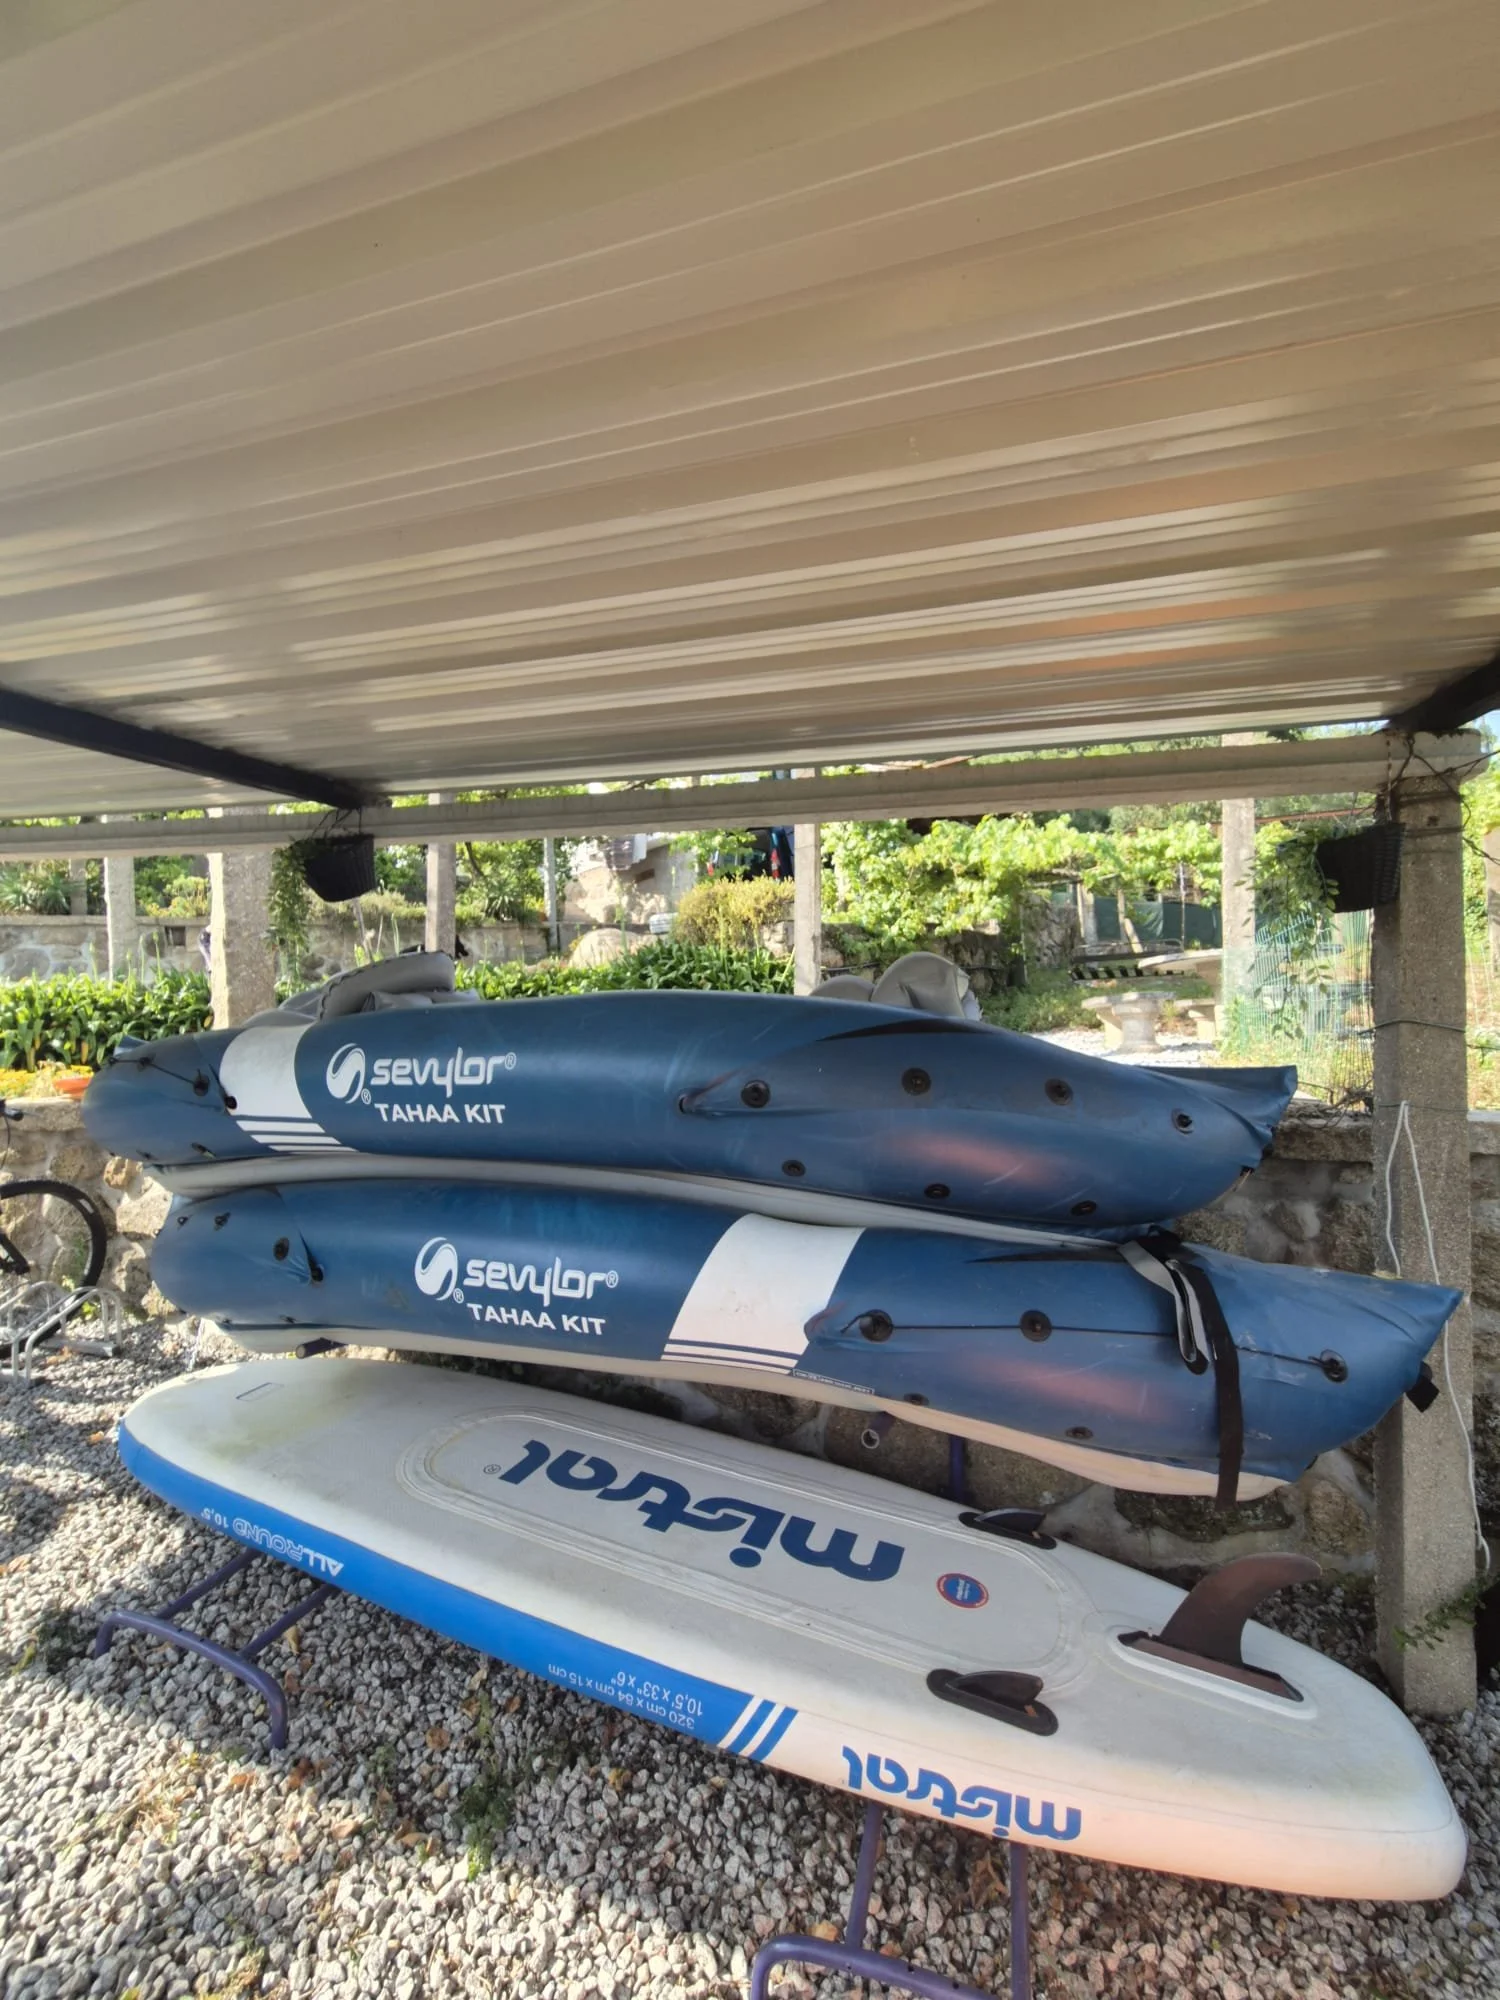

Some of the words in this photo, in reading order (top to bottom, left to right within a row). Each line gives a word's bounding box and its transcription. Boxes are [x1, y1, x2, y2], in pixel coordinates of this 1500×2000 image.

[374, 1103, 460, 1123] TAHAA
[464, 1104, 506, 1124] KIT
[467, 1303, 556, 1330] TAHAA
[562, 1314, 606, 1335] KIT
[232, 1517, 345, 1577] ALLROUND
[548, 1664, 567, 1678] cm
[568, 1672, 584, 1686] 15
[585, 1676, 593, 1689] x
[628, 1674, 637, 1688] x
[595, 1682, 615, 1697] cm
[663, 1688, 671, 1702] x
[618, 1690, 634, 1706] 84
[636, 1697, 644, 1708] x
[646, 1701, 666, 1717] cm
[669, 1713, 695, 1730] 320
[842, 1745, 1082, 1841] mistral
